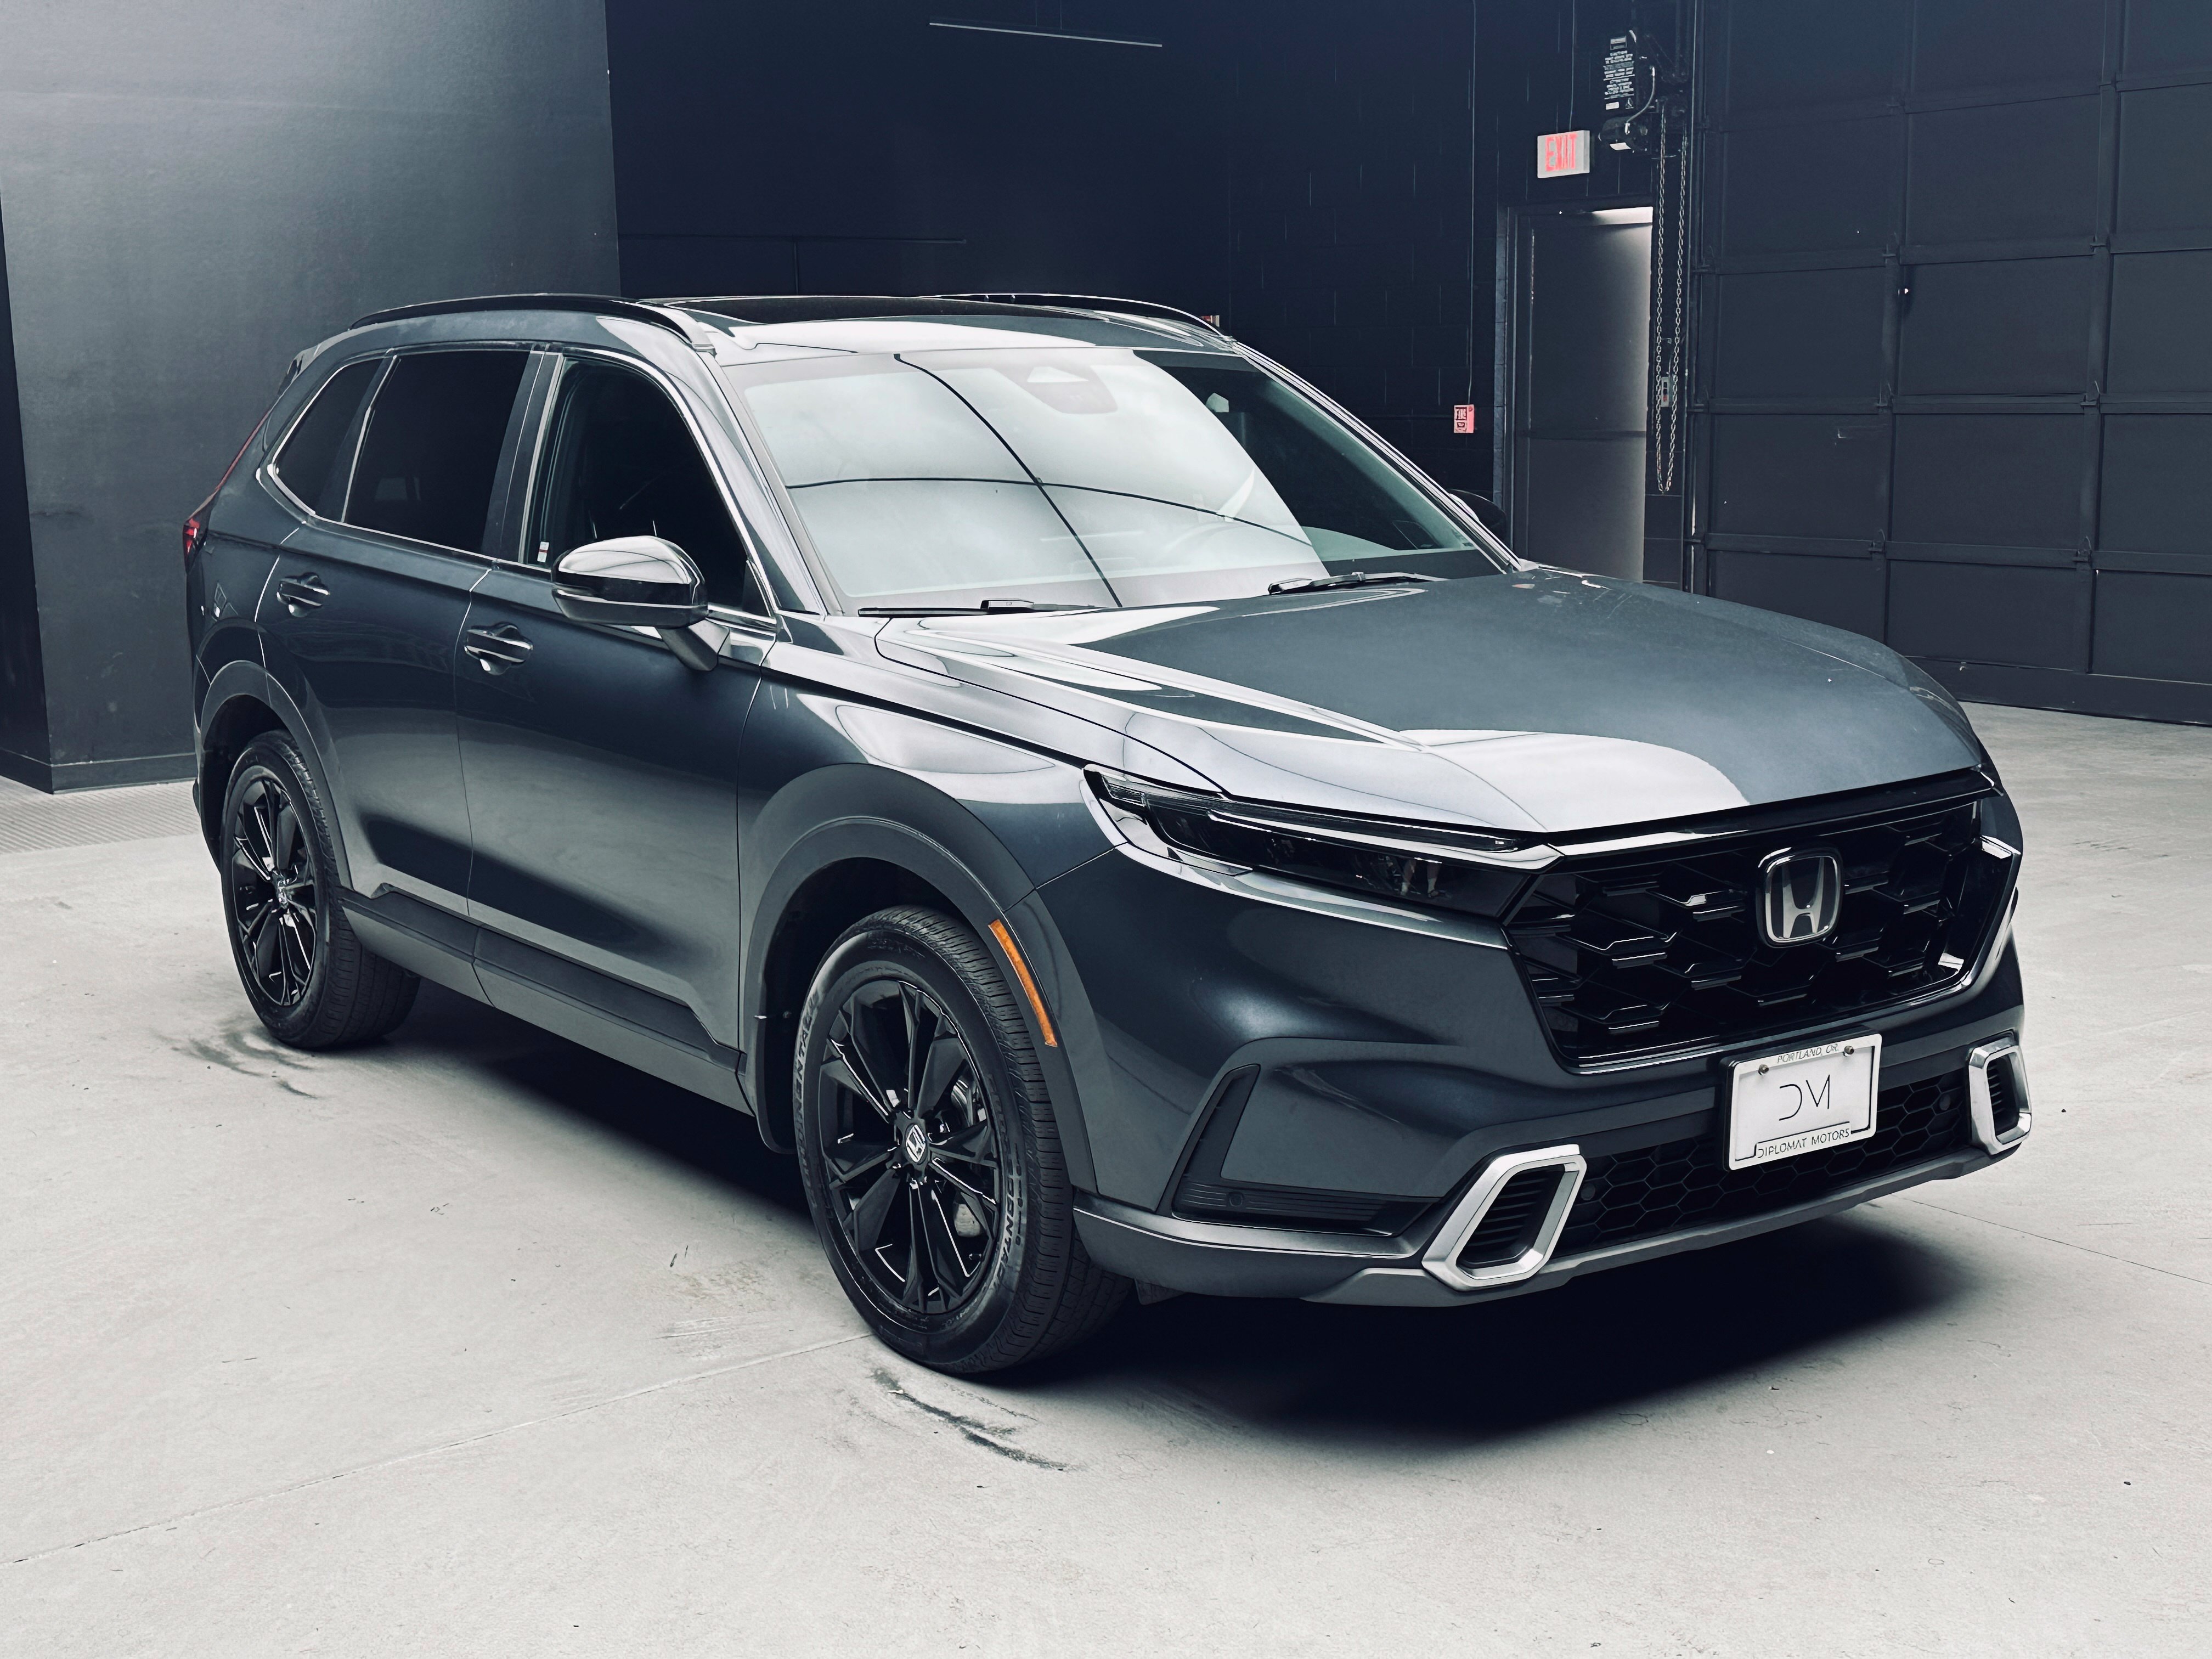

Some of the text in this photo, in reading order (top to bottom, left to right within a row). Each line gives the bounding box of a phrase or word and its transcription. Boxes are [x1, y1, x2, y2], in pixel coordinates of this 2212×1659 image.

[1545, 133, 1578, 172] EXIT
[1757, 1128, 1850, 1159] DIPLOMAT MOTORS
